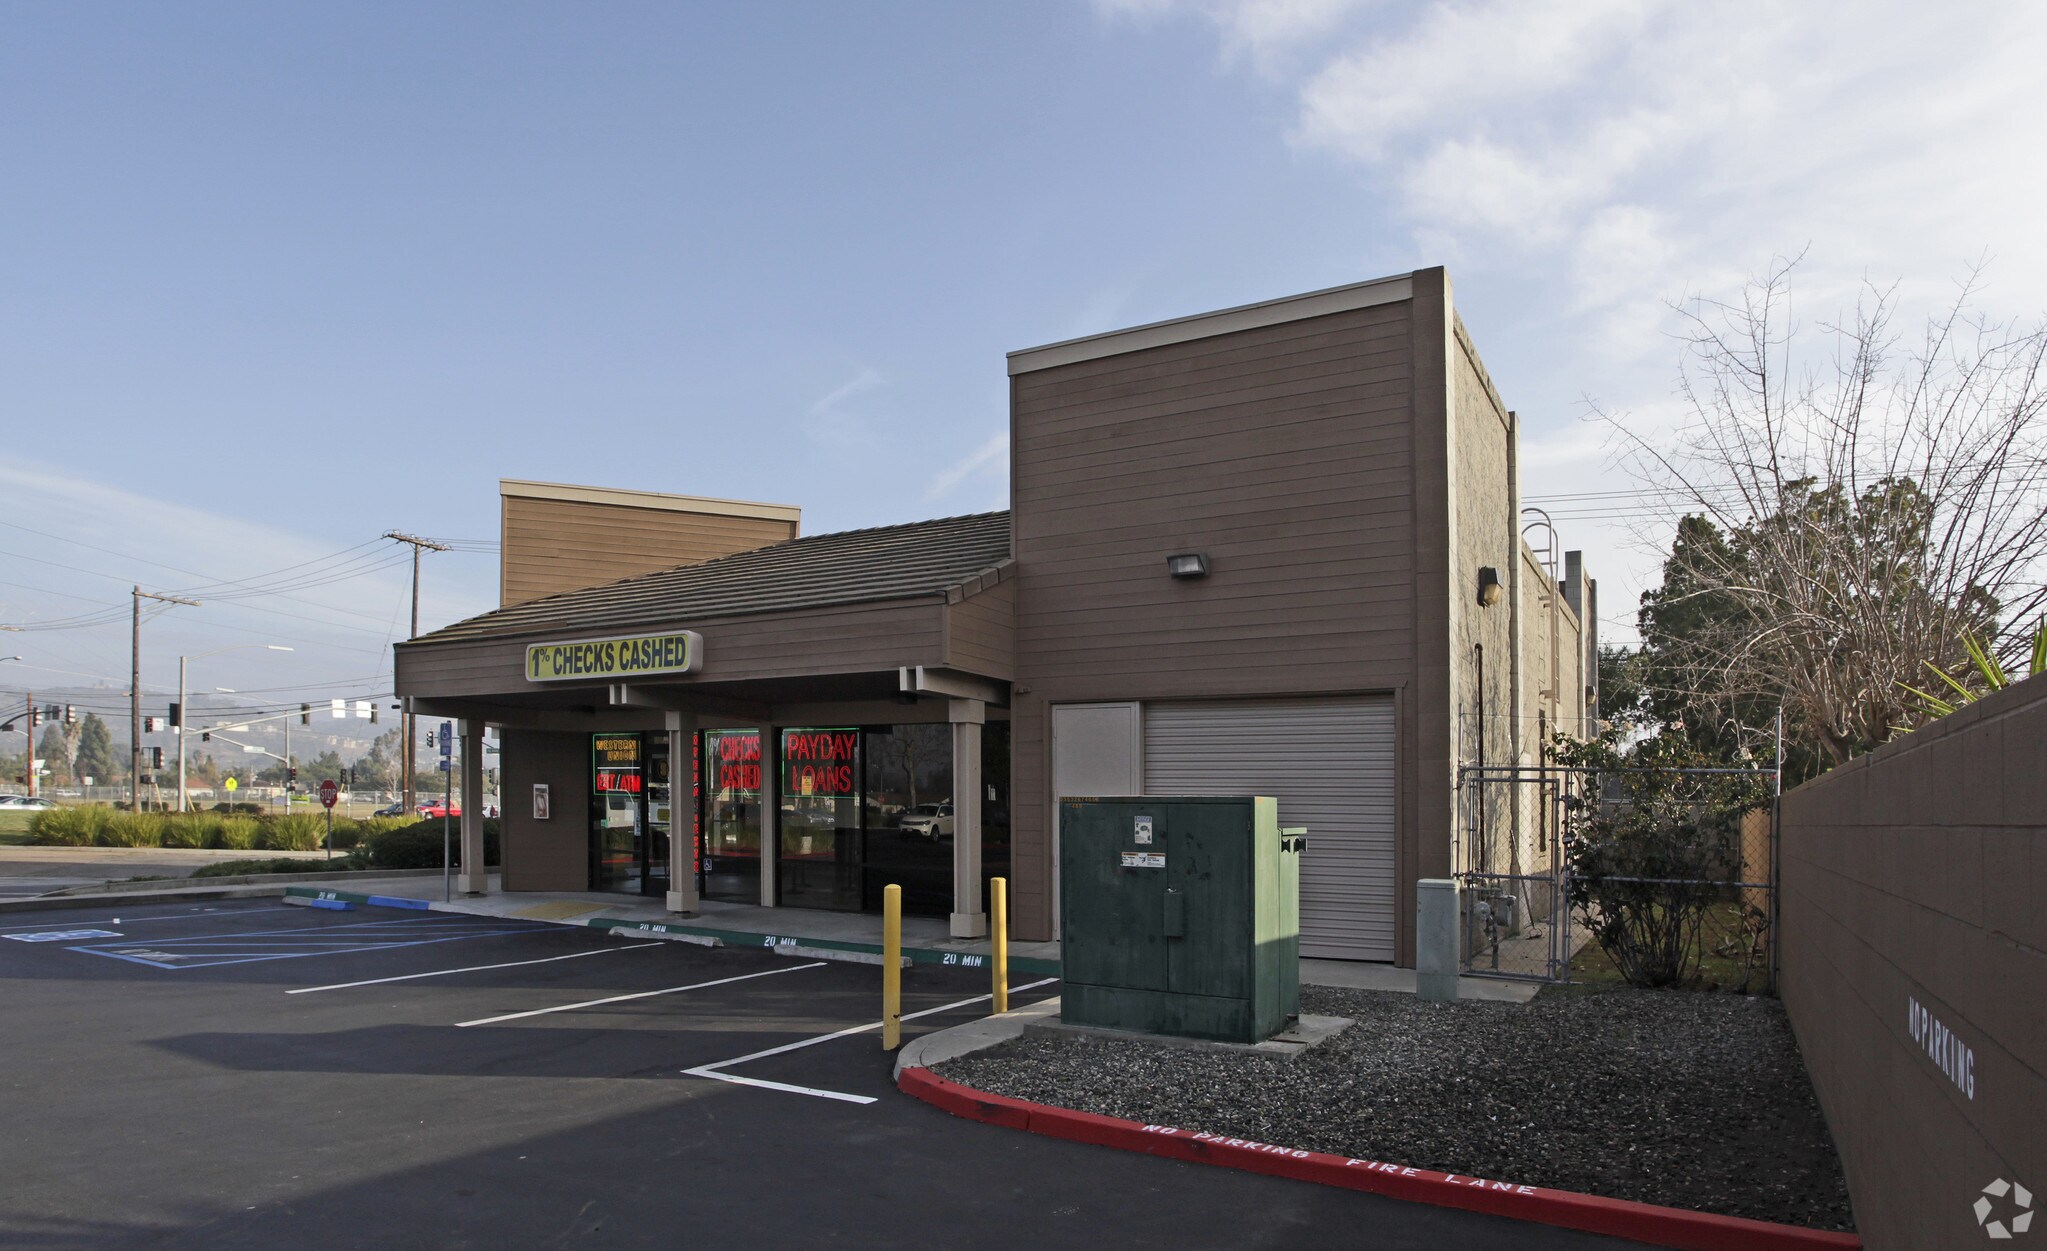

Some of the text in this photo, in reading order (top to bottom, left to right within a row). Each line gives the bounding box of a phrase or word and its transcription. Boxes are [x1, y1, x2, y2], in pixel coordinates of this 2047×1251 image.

[553, 642, 615, 675] CHECKS
[619, 636, 686, 671] CASHED
[720, 736, 761, 761] CHECKS
[787, 733, 856, 760] PAYDAY
[720, 764, 761, 789] CASHED
[792, 765, 852, 793] LOANS
[320, 788, 337, 800] STOP
[763, 935, 797, 947] 20 MIN
[942, 953, 982, 967] 20 MIN
[1141, 1124, 1537, 1195] NO PARKING FIRE LANE
